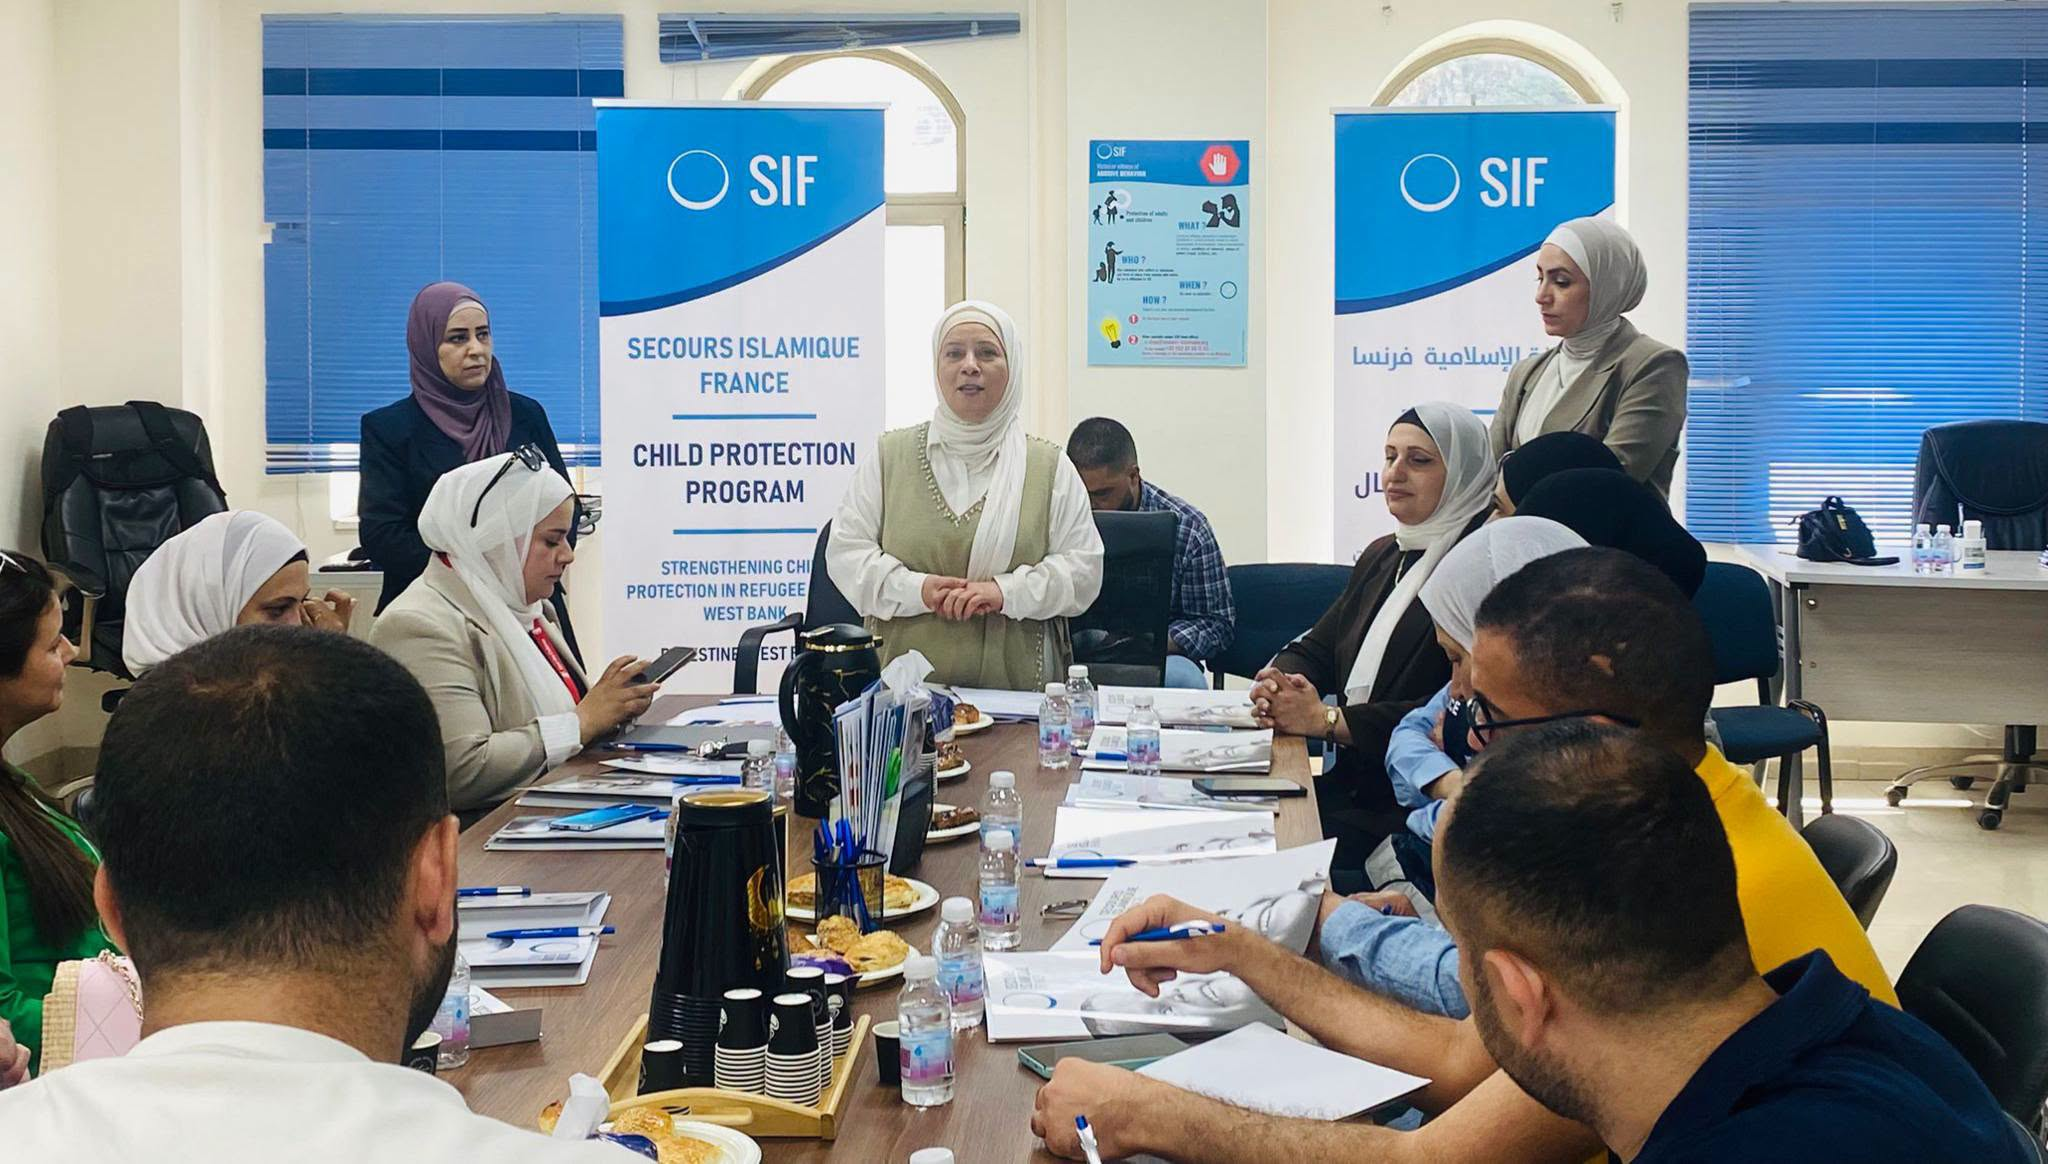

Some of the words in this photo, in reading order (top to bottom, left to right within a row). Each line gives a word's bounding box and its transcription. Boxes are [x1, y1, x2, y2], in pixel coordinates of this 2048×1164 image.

[1112, 146, 1127, 157] SIF
[748, 154, 819, 208] SIF
[1479, 156, 1549, 208] SIF
[1178, 221, 1200, 231] WHAT
[1121, 256, 1139, 265] WHO
[1179, 281, 1201, 290] WHEN
[1142, 296, 1160, 304] HOW
[628, 337, 733, 360] SECOURS
[740, 336, 860, 359] ISLAMIQUE
[1353, 346, 1413, 371] فرنسا
[1425, 346, 1520, 372] الإسلامية
[701, 371, 790, 395] FRANCE
[633, 442, 704, 468] CHILD
[710, 441, 856, 467] PROTECTION
[686, 479, 804, 504] PROGRAM
[661, 559, 783, 576] STRENGTHENING
[786, 559, 810, 574] CHI
[627, 583, 719, 600] PROTECTION
[721, 583, 736, 598] IN
[740, 582, 806, 598] REFUGEE
[703, 606, 744, 621] WEST
[747, 604, 787, 620] BANK
[761, 646, 787, 660] EST
